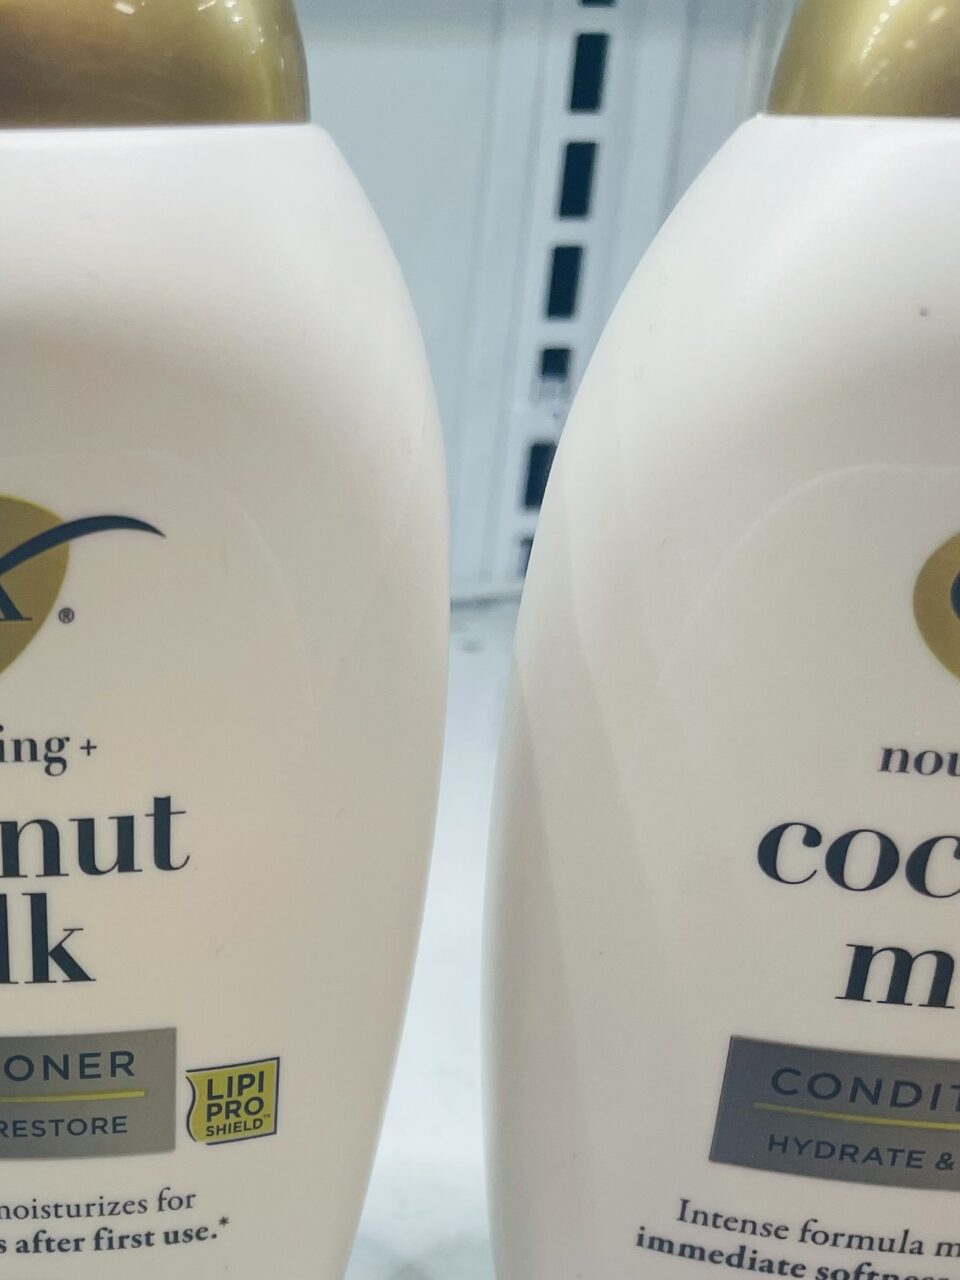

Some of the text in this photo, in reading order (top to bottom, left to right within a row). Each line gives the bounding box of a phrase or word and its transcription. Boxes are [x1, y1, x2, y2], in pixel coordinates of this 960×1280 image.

[206, 1071, 265, 1101] LIPI
[206, 1096, 265, 1121] PRO
[767, 1133, 955, 1171] HYDRATE &
[157, 1187, 197, 1213] for
[15, 1230, 84, 1254] after
[93, 1226, 156, 1251] first
[676, 1198, 790, 1240] Intense
[799, 1219, 924, 1257] formula
[635, 1226, 806, 1279] immediate
